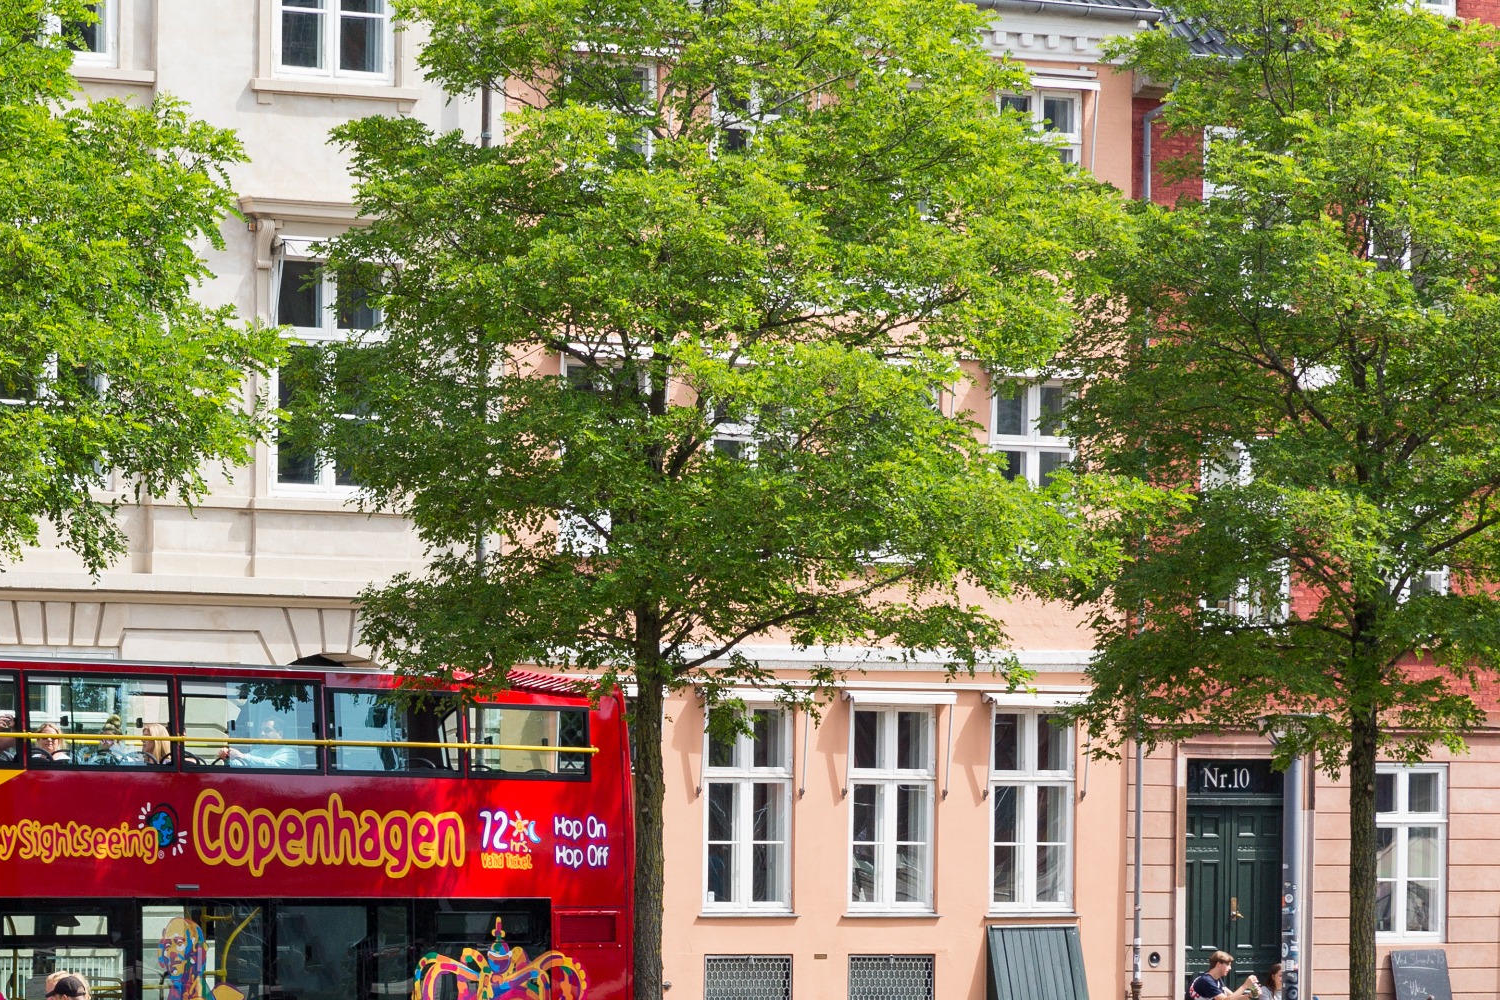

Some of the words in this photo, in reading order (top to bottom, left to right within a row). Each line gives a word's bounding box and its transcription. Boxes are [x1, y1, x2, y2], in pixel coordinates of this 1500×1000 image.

[1202, 767, 1250, 789] Nr.10
[193, 788, 466, 878] Copenhagen
[479, 810, 508, 849] 72
[510, 839, 532, 853] hrs.
[554, 816, 583, 841] Hop
[586, 815, 607, 838] On
[17, 818, 158, 865] Sightseeing
[481, 852, 504, 869] Valid
[505, 853, 533, 870] Ticket
[555, 845, 584, 869] Hop
[587, 844, 609, 867] Off
